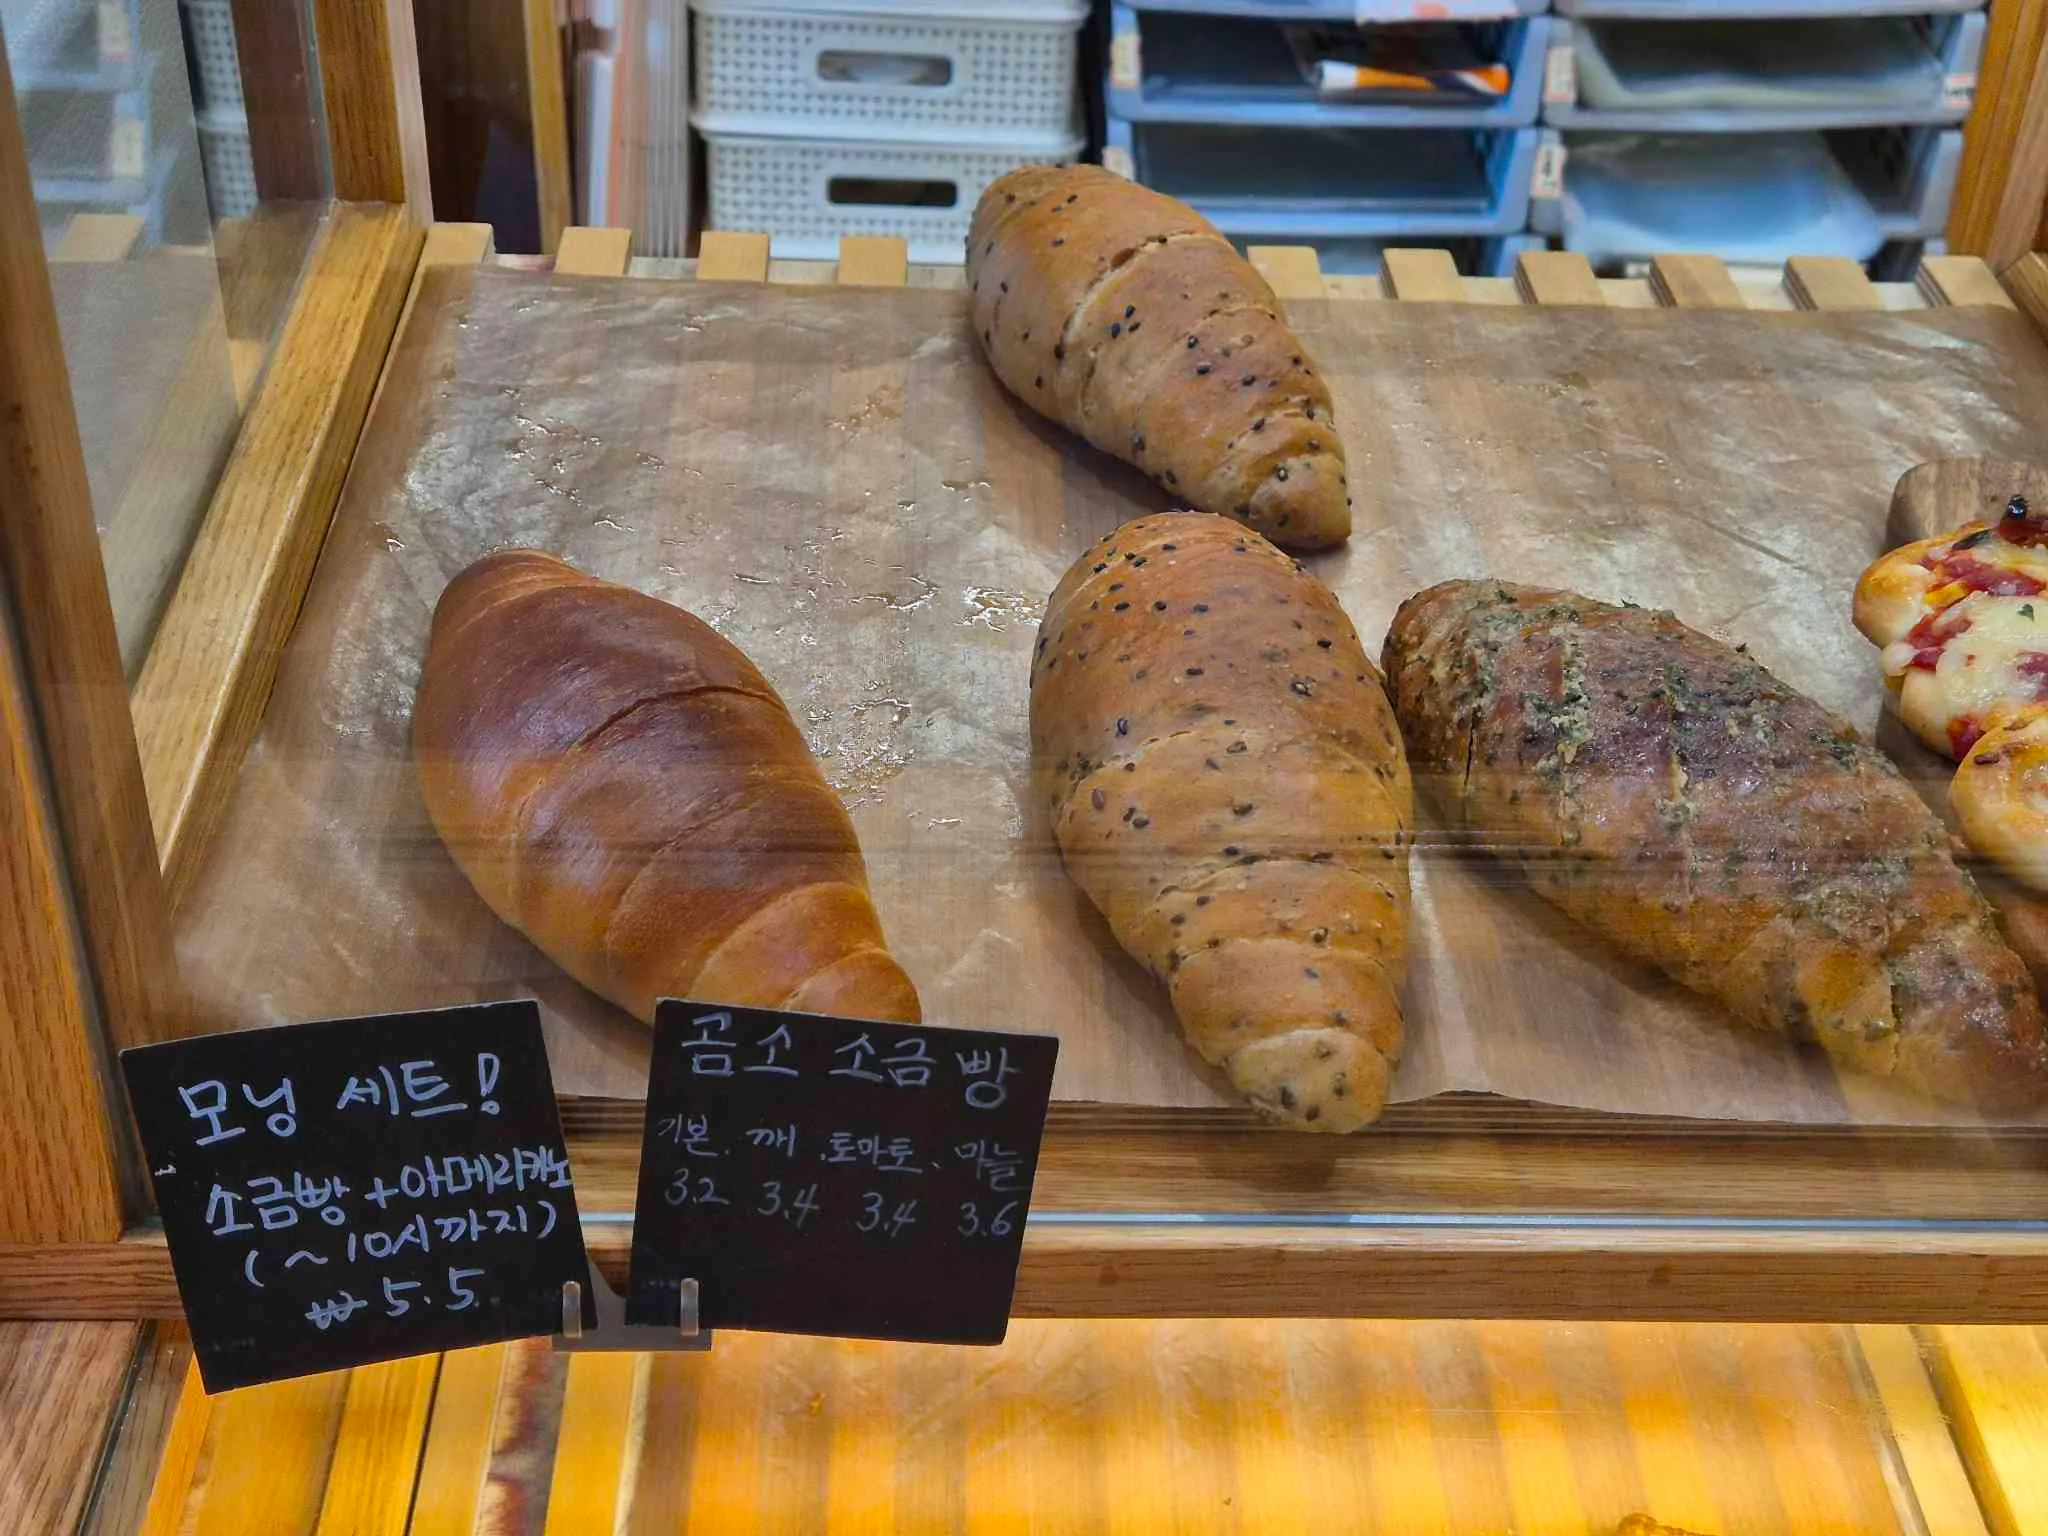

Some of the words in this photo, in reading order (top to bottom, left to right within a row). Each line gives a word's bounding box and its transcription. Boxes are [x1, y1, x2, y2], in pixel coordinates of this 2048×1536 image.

[681, 1011, 799, 1077] 곰소
[829, 1032, 1020, 1110] 소금빵
[178, 1079, 297, 1146] 모닝
[745, 1124, 797, 1157] 깨
[205, 1172, 351, 1236] 소금빵
[664, 1167, 731, 1206] 3.2
[757, 1180, 821, 1230] 3.4
[856, 1191, 918, 1240] 3.4
[957, 1200, 1019, 1237] 3.6
